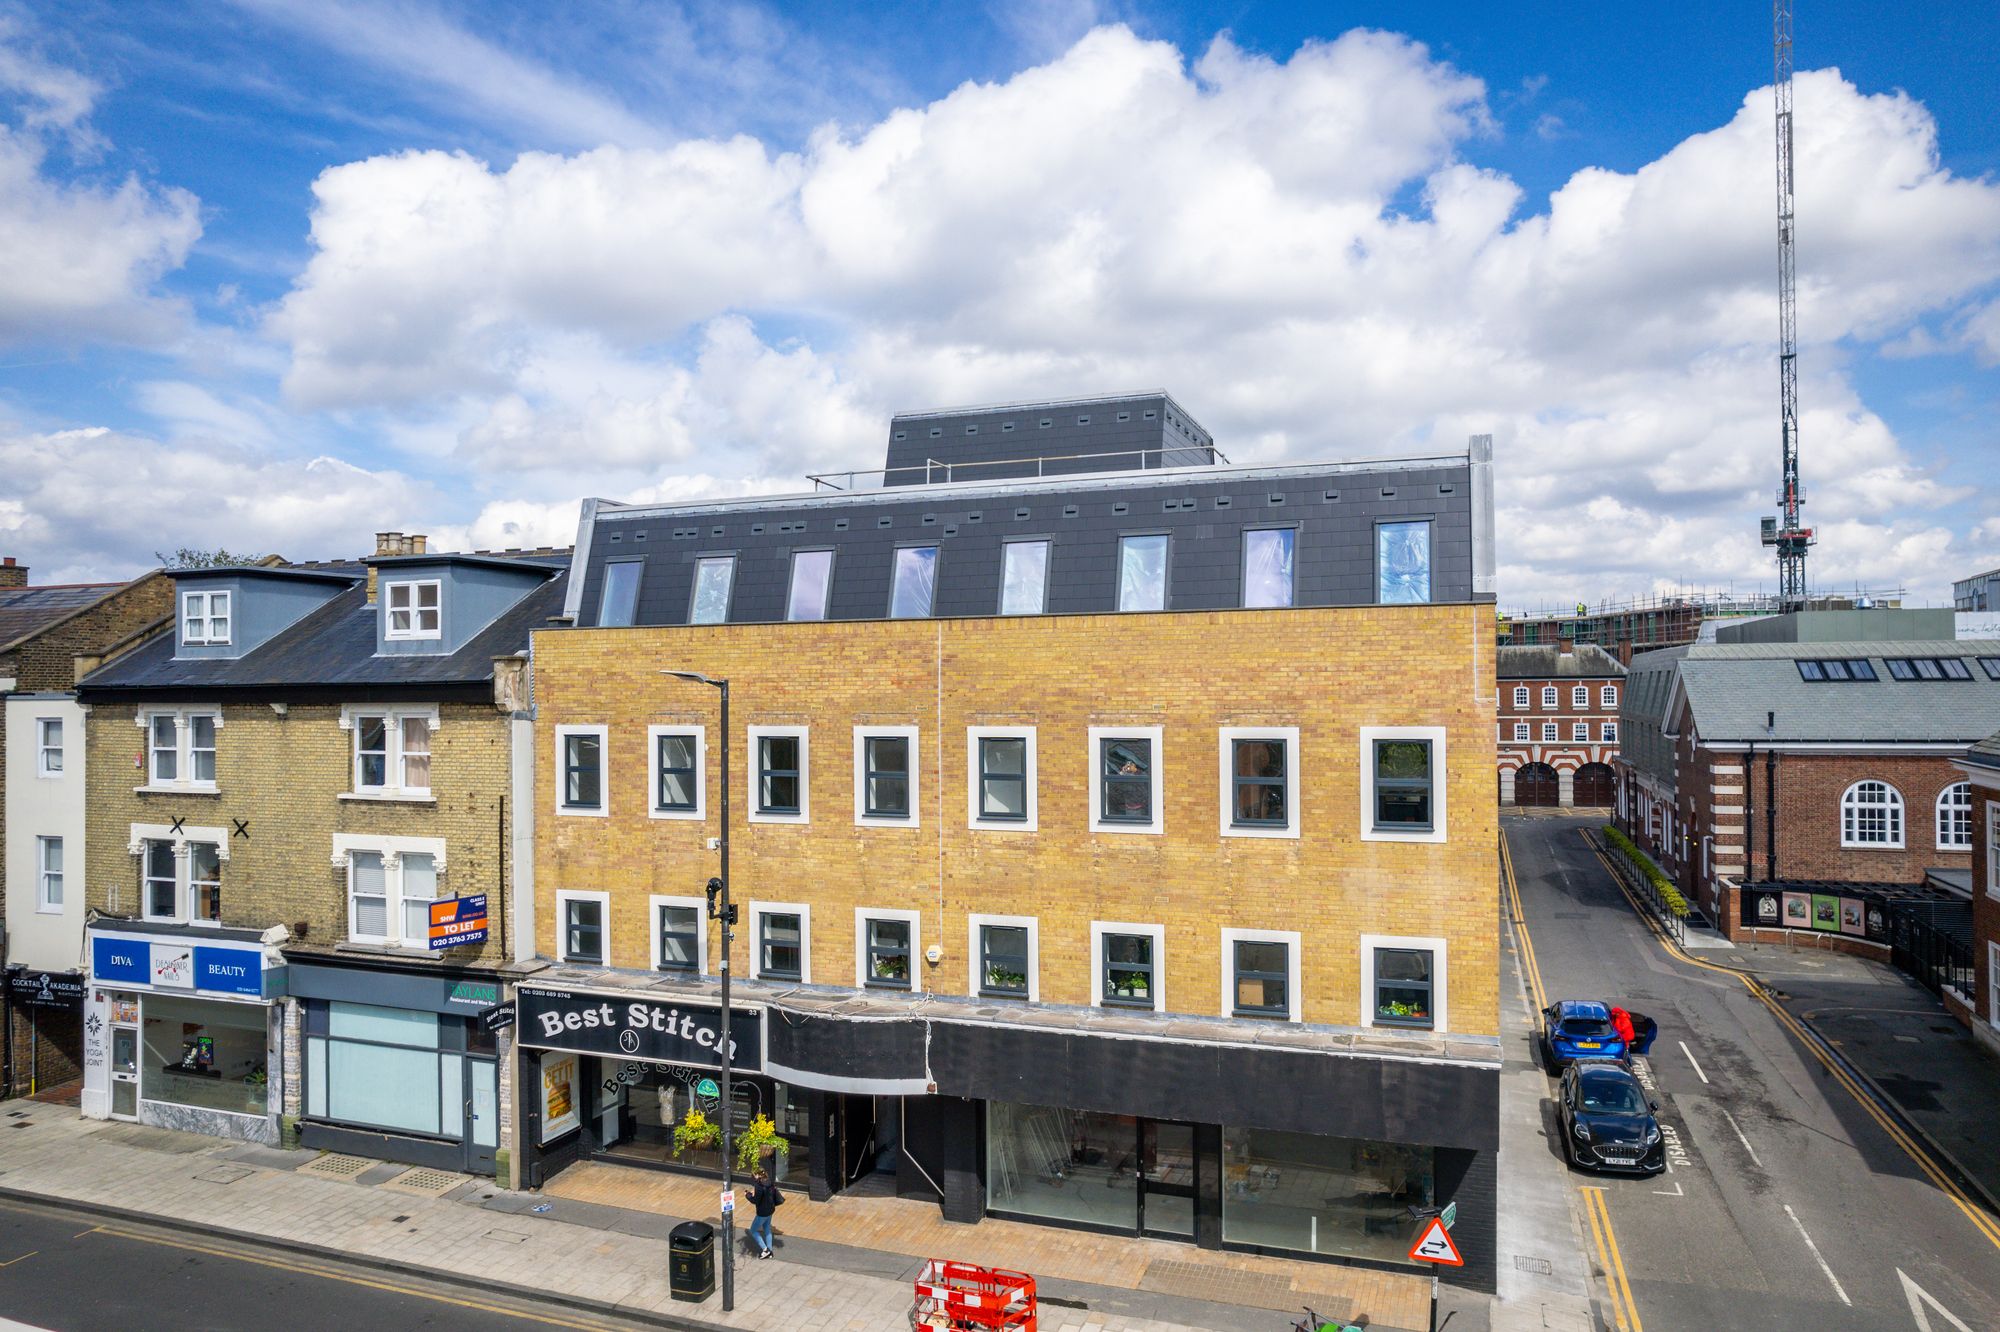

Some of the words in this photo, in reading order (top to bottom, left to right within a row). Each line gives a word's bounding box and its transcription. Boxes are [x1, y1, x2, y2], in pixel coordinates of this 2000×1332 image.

[440, 915, 455, 923] SHW
[444, 924, 458, 934] TO
[460, 921, 475, 932] LET
[433, 939, 448, 947] 020
[448, 934, 466, 944] 3763
[466, 932, 482, 941] 7575
[111, 955, 132, 967] DIVA
[208, 964, 246, 977] BEAUTY
[12, 978, 42, 988] COCKTAIL
[49, 982, 82, 991] AKADEMIA
[538, 1003, 616, 1038] Best
[86, 1049, 103, 1057] YOGA
[86, 1059, 103, 1067] JOINT
[602, 1061, 648, 1096] Best
[655, 1062, 720, 1115] Stith
